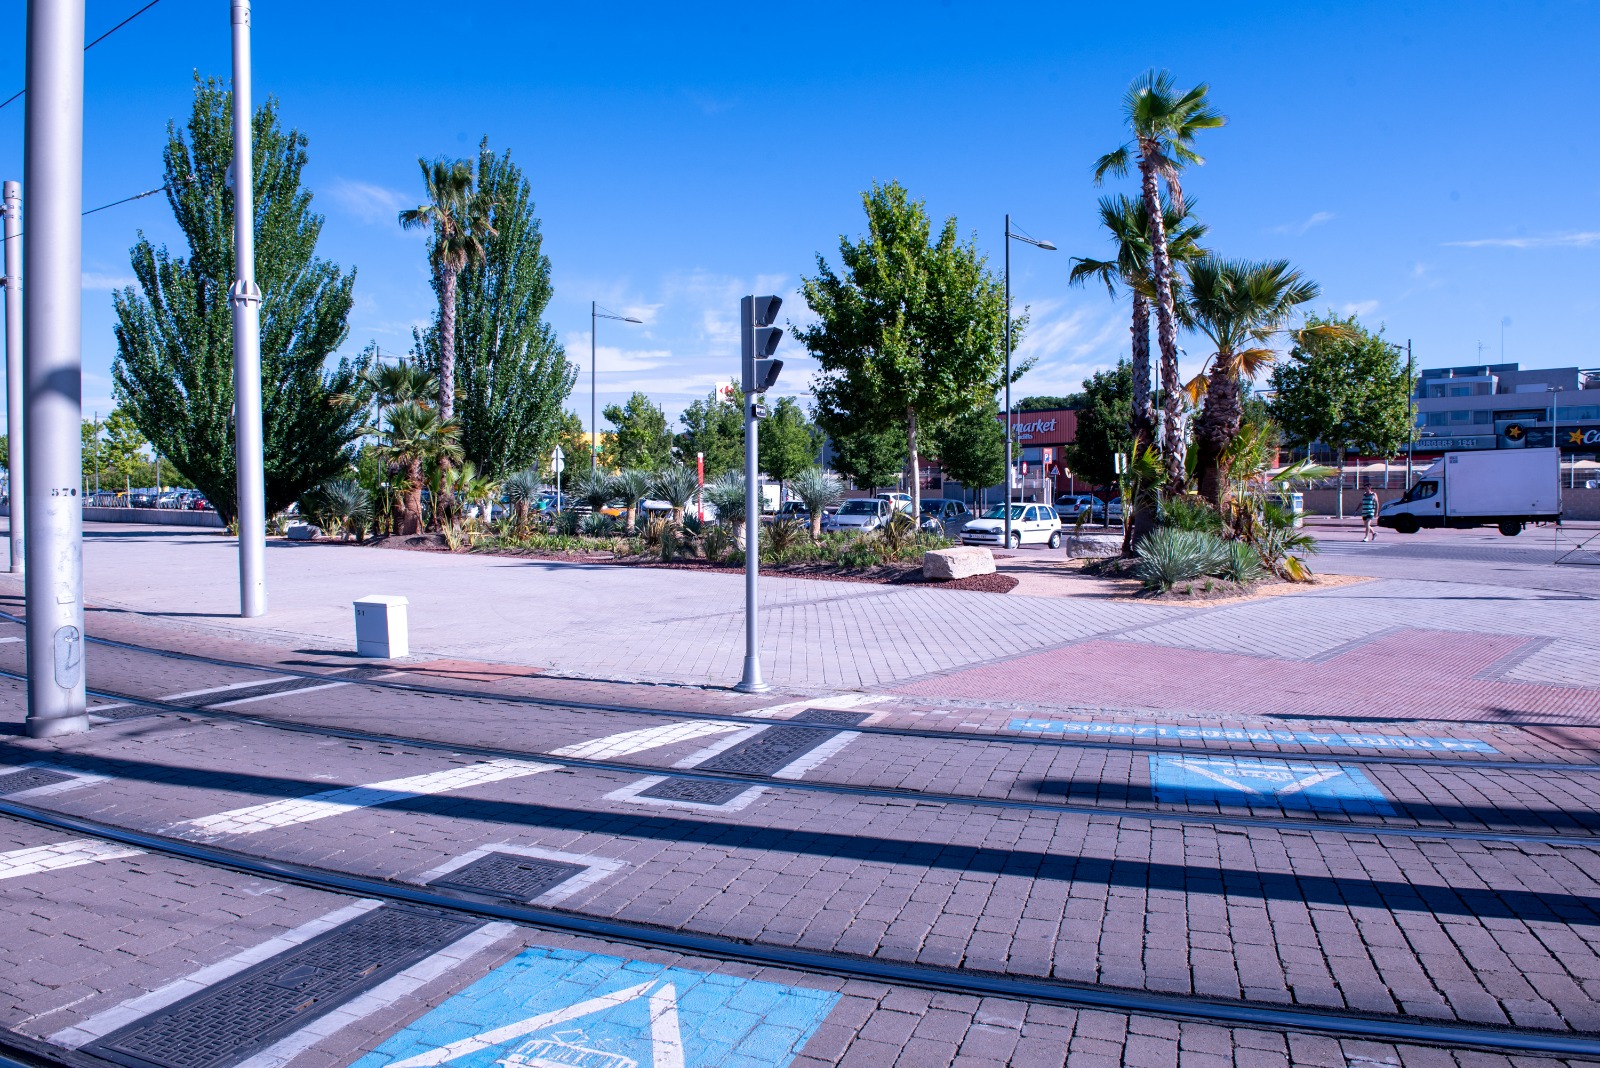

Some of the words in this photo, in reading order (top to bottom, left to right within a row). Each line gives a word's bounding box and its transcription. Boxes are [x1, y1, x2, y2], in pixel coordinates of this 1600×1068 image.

[1012, 418, 1057, 433] market
[1414, 439, 1453, 448] BURGERS
[1457, 438, 1478, 447] 1941
[51, 487, 77, 497] 570
[1063, 722, 1168, 736] LADOS
[1177, 728, 1296, 743] AMBOS
[1307, 734, 1331, 743] A
[1346, 735, 1434, 749] MIRE
